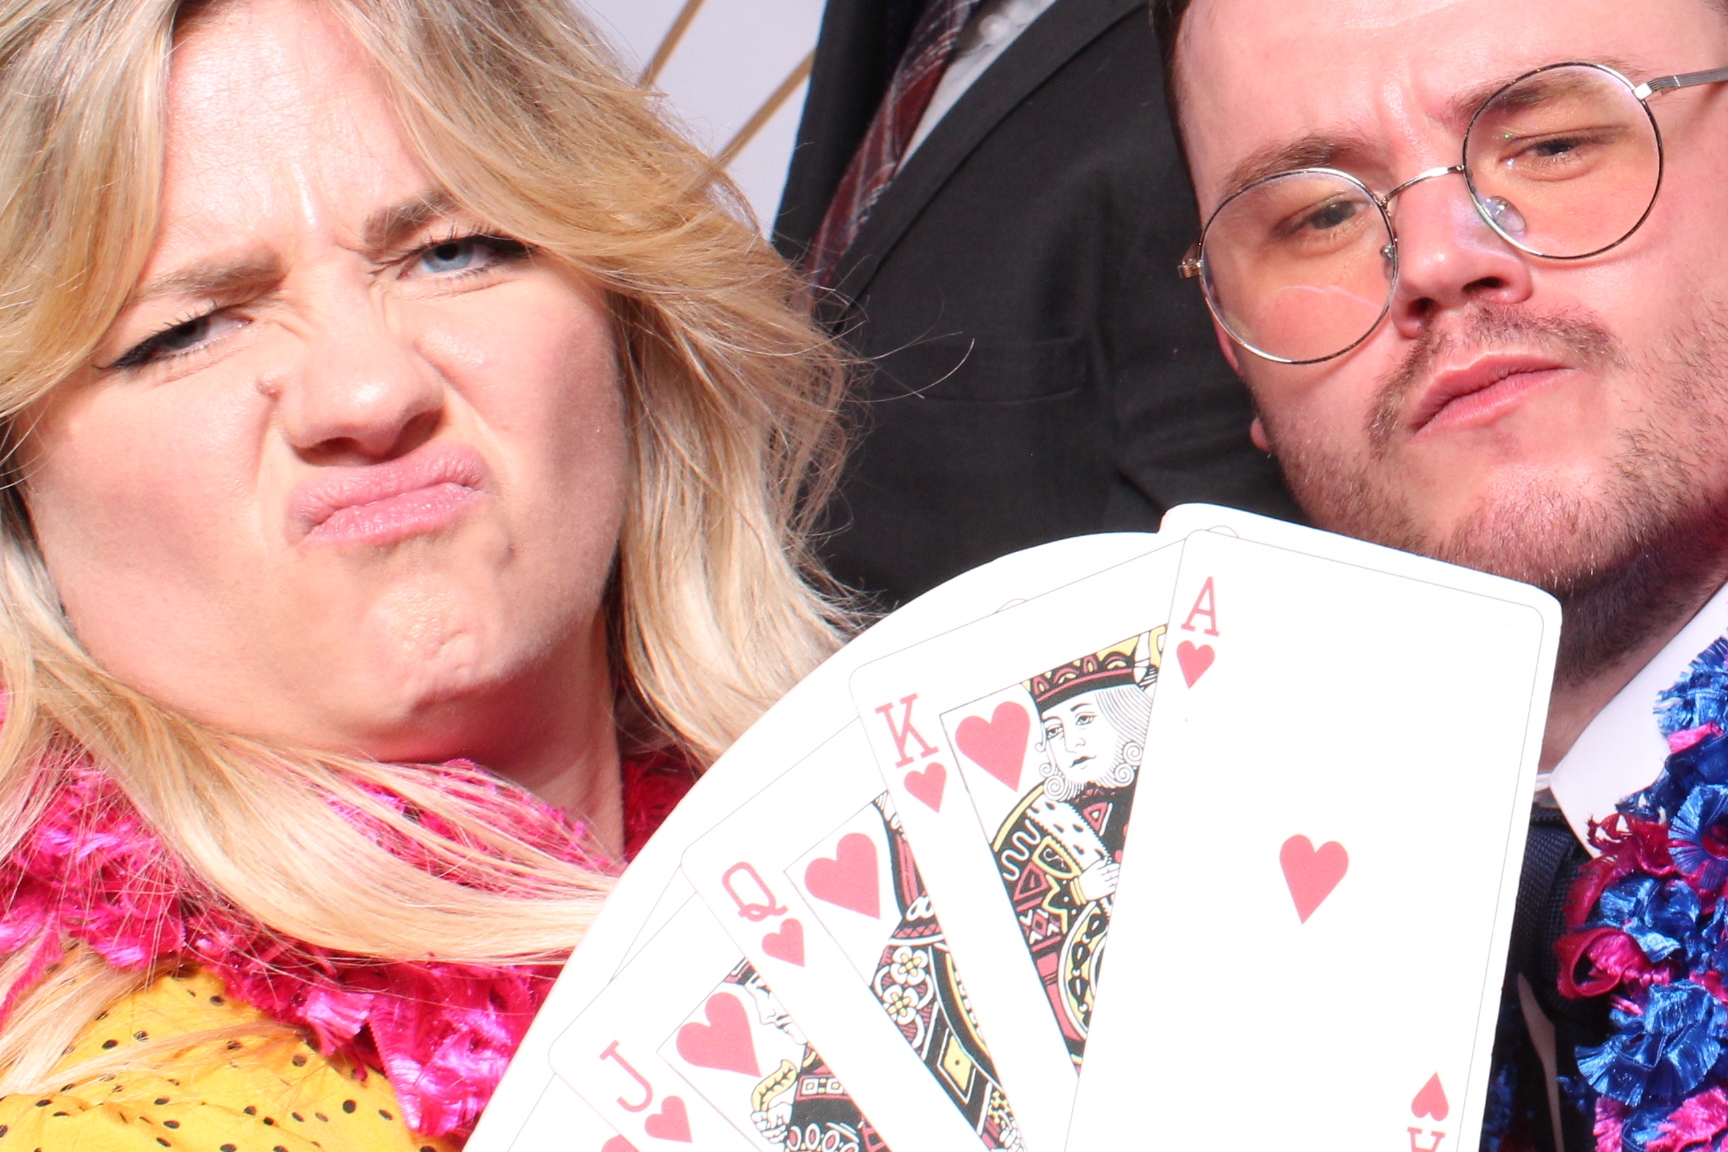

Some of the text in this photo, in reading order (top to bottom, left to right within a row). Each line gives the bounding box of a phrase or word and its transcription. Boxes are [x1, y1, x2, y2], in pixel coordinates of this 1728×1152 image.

[1181, 576, 1220, 637] A
[874, 692, 940, 769] K
[721, 861, 788, 923] Q
[599, 1039, 654, 1113] J
